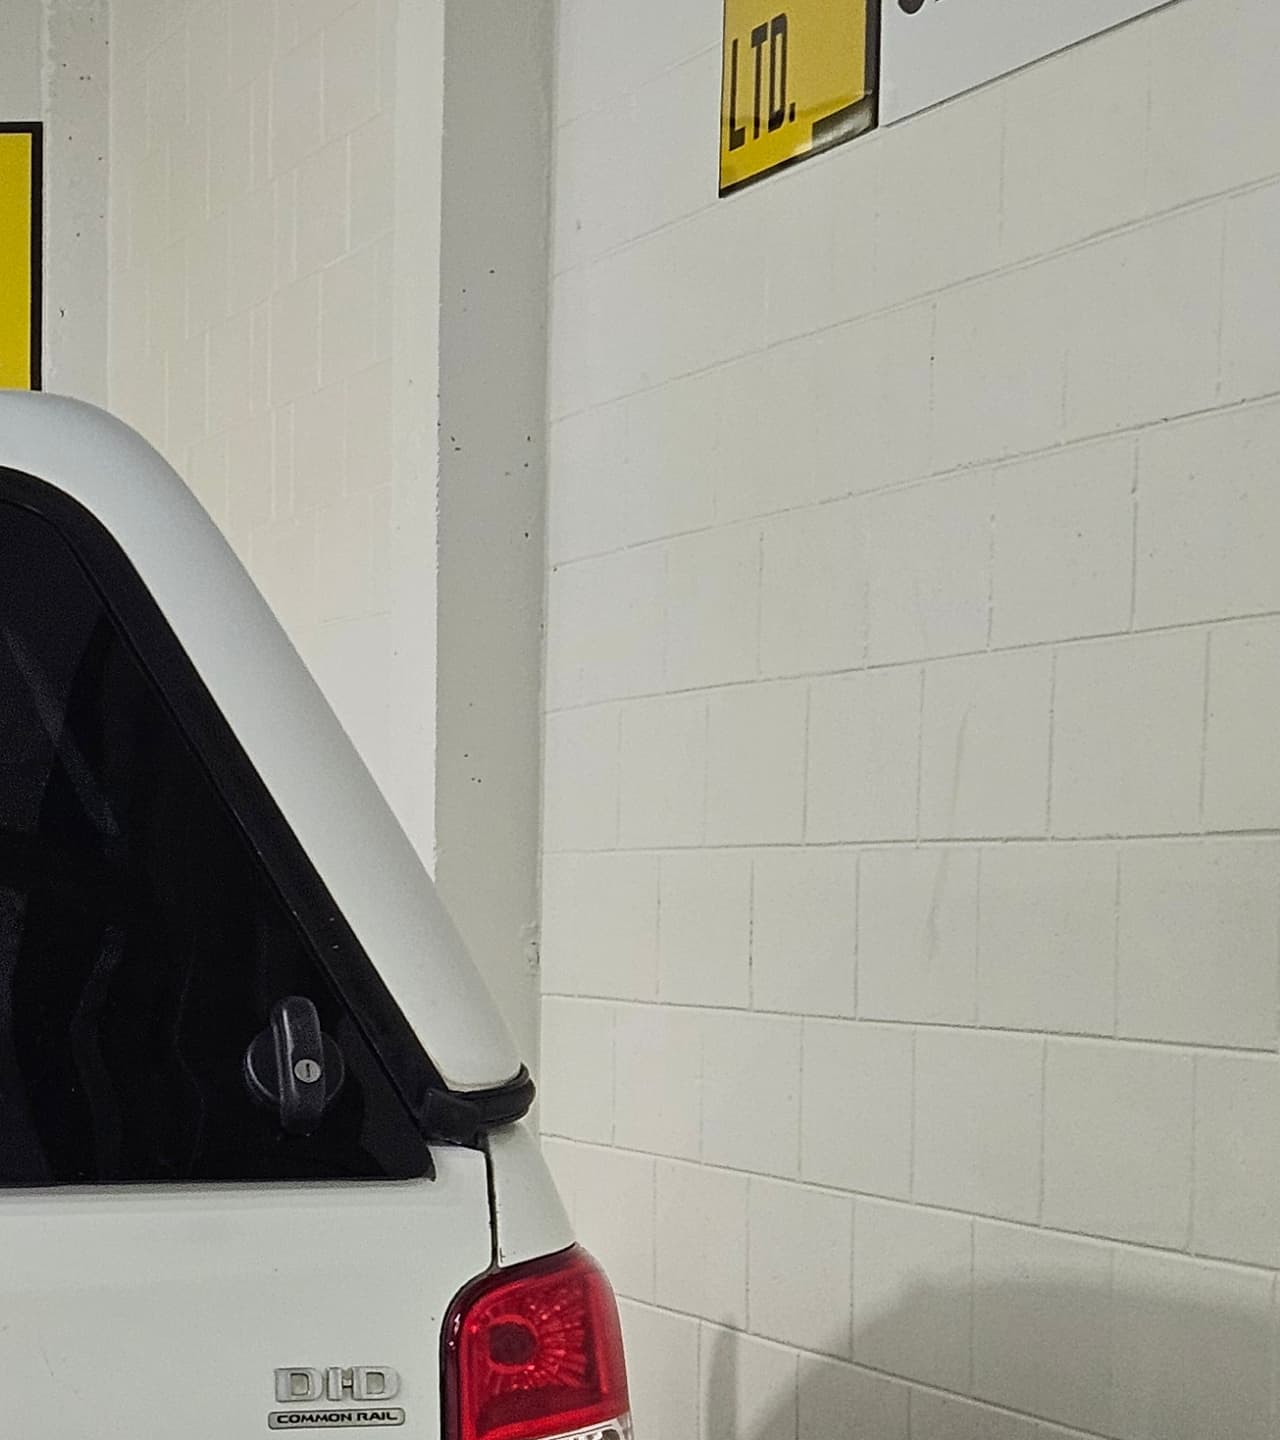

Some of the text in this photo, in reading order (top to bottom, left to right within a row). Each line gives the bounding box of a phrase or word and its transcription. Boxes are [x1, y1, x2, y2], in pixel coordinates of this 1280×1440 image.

[728, 12, 797, 152] LTD.
[276, 1410, 399, 1425] COMMON RAIL
